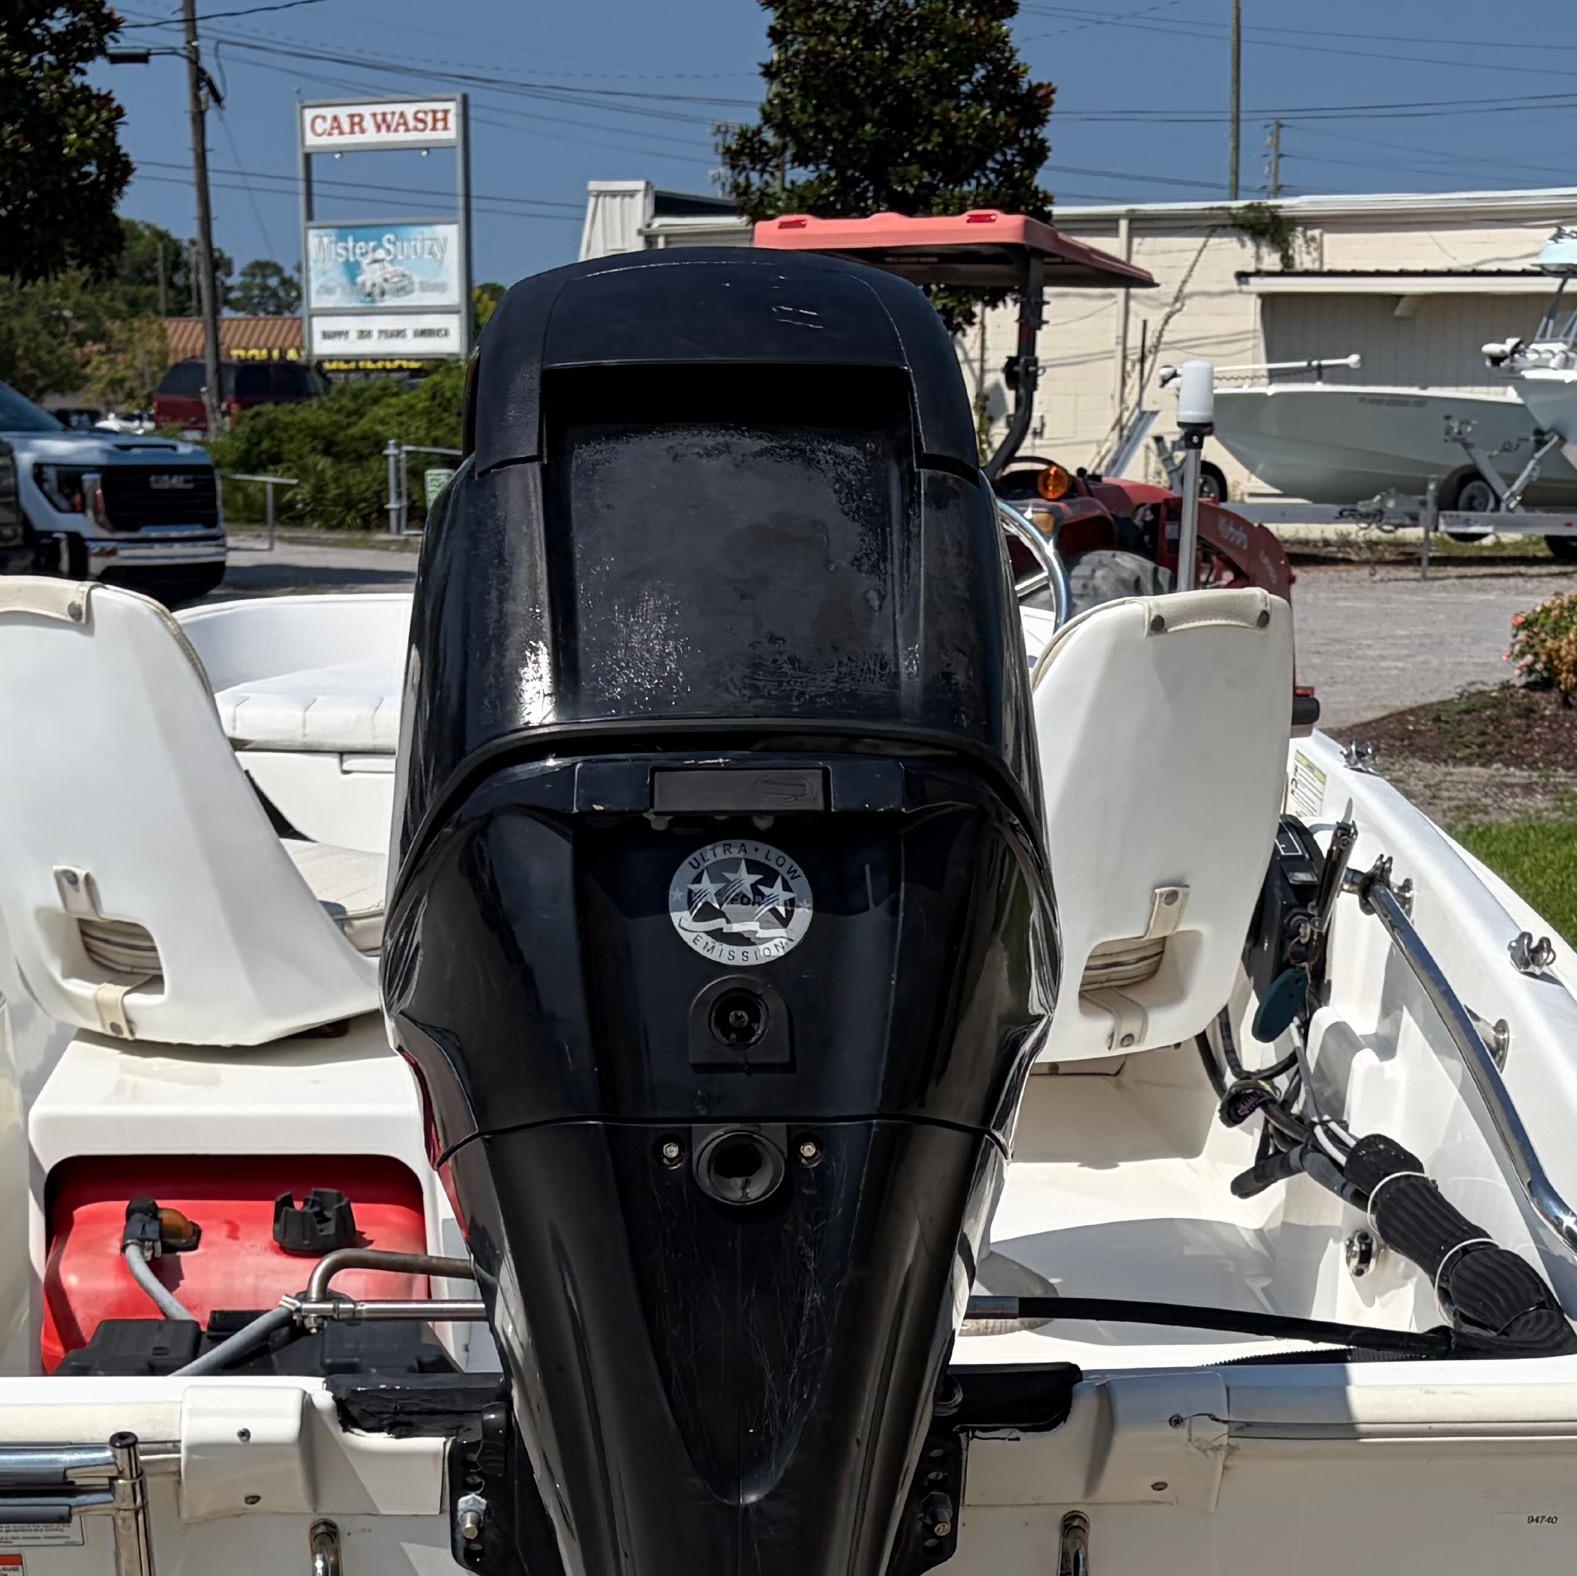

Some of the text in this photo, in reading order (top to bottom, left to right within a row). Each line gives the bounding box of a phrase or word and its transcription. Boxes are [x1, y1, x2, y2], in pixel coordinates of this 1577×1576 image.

[310, 108, 451, 137] CAR WASH
[230, 347, 304, 361] DOLLA
[689, 843, 802, 881] ULTRA LOW
[692, 934, 788, 962] EMISSION
